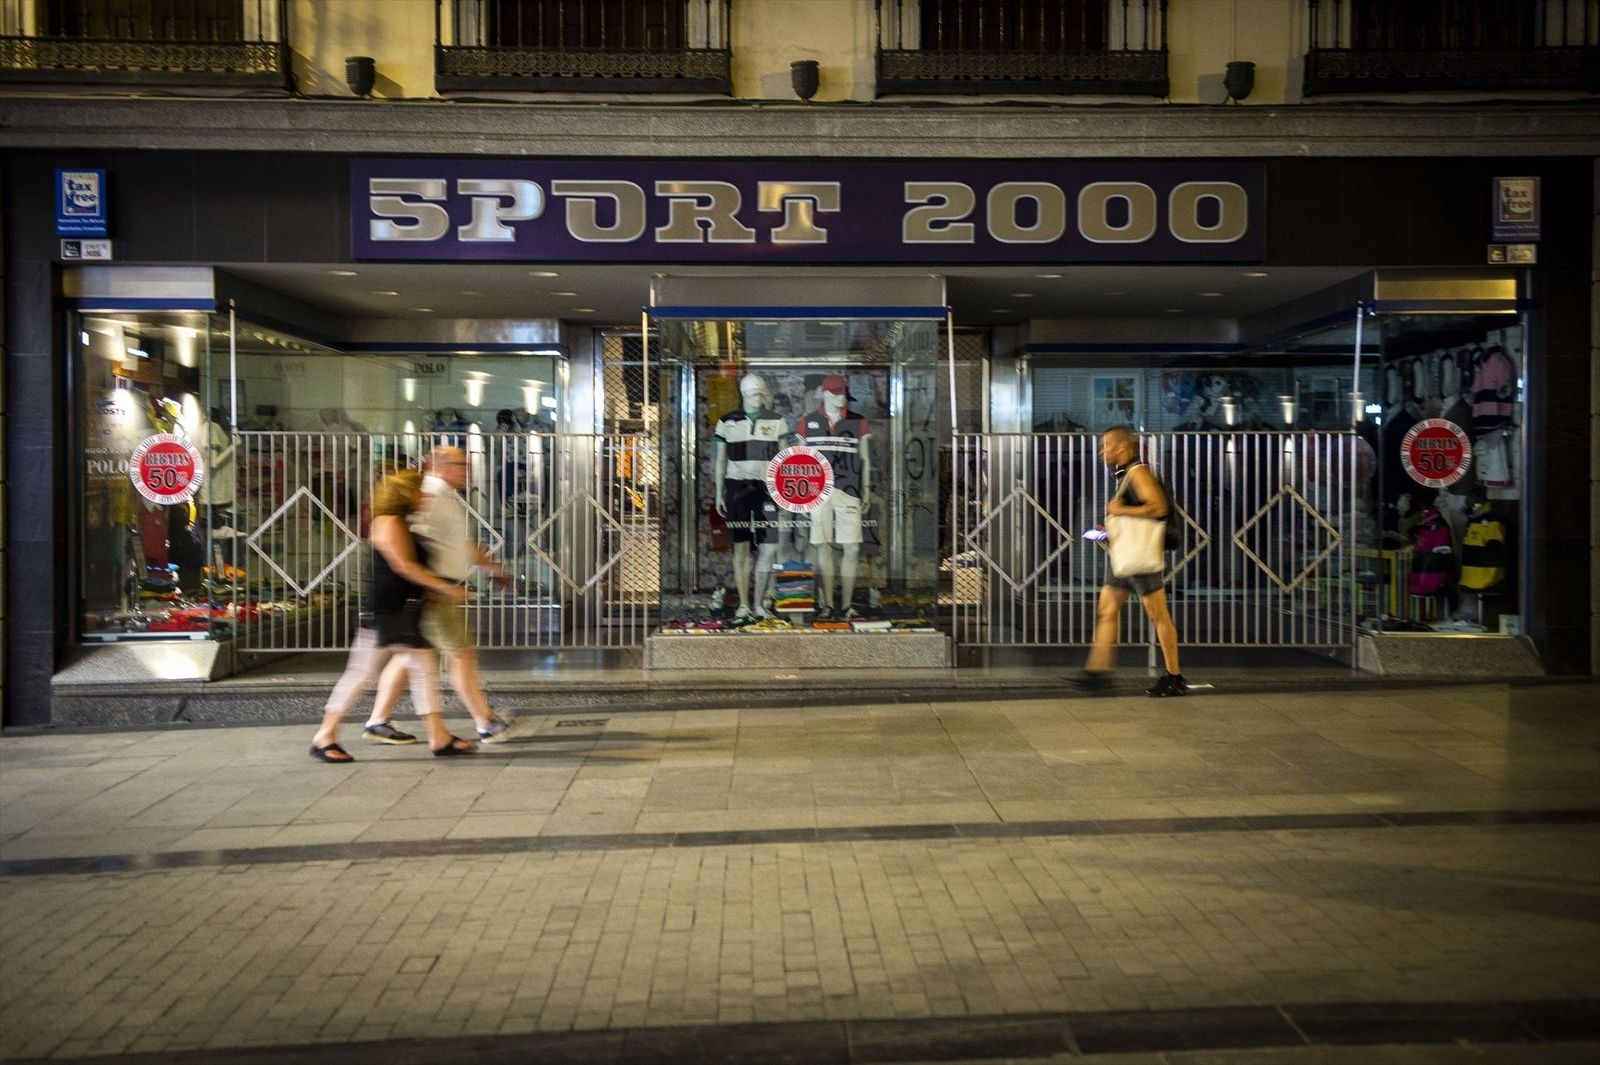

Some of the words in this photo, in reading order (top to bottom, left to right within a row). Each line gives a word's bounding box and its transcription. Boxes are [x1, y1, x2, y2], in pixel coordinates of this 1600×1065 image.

[66, 179, 93, 191] tax
[369, 178, 841, 244] SPORT
[902, 181, 1249, 244] 2000
[87, 460, 130, 474] POLO
